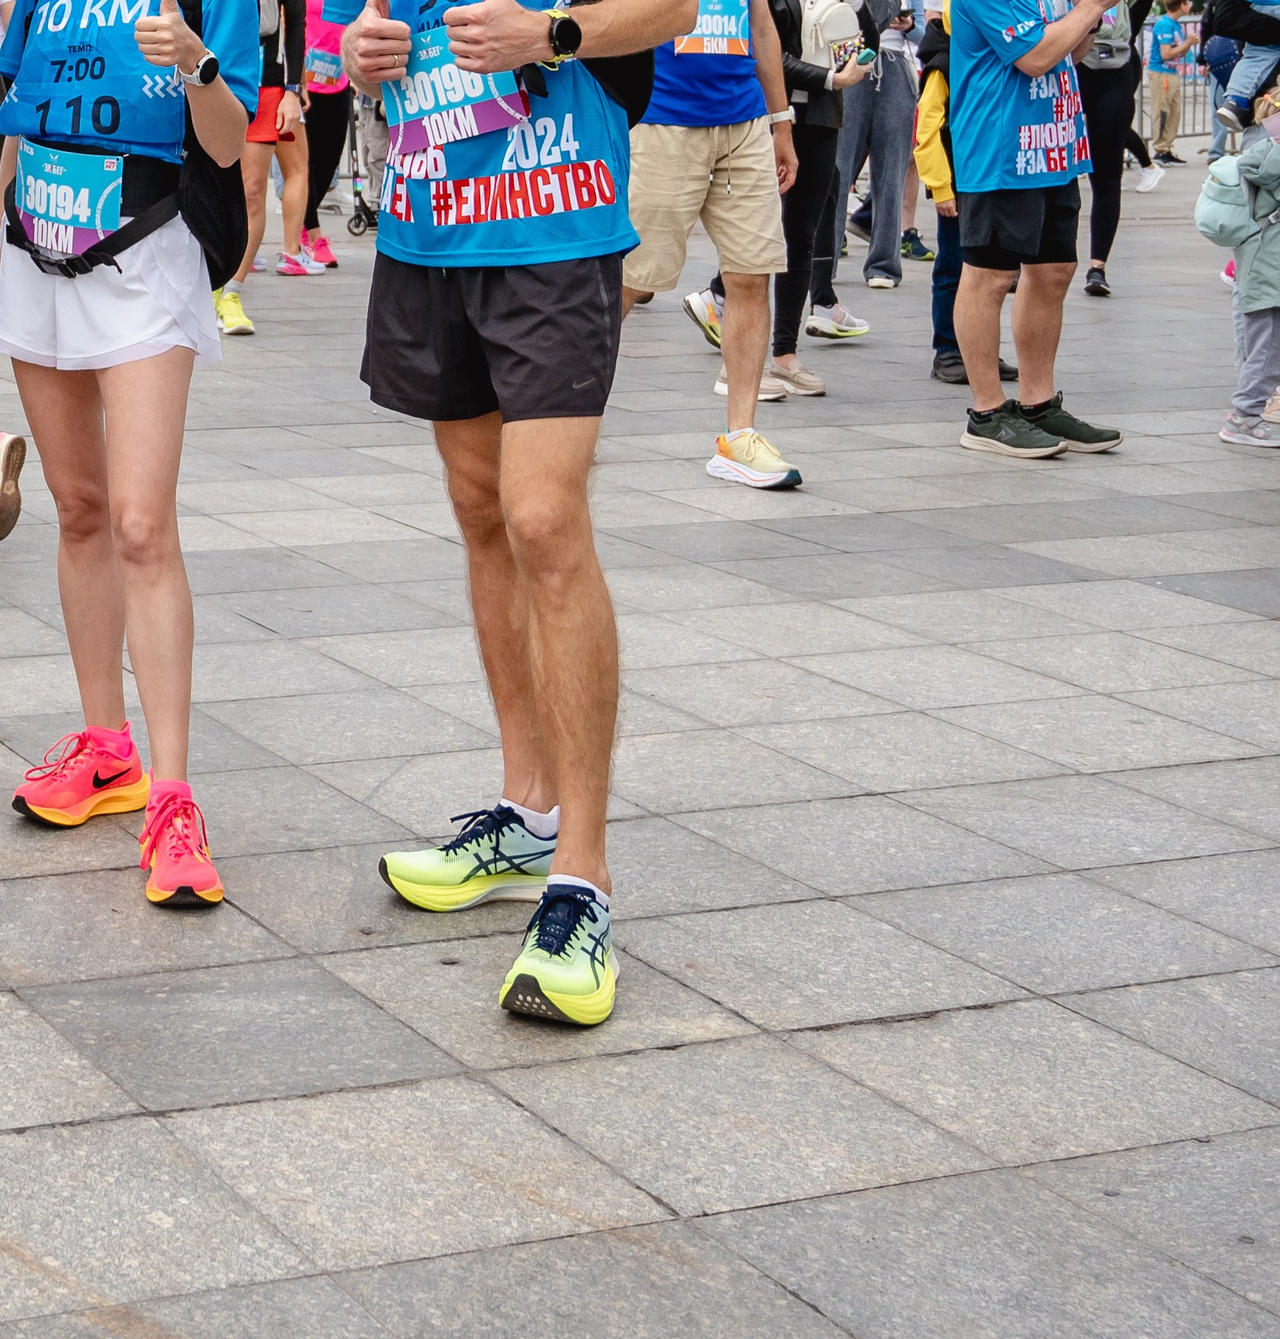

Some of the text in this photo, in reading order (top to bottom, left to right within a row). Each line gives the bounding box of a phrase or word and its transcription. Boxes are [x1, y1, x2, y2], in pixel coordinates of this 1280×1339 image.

[67, 44, 94, 53] ТЕМП:
[703, 37, 728, 54] 5KM
[51, 57, 106, 83] 7:00
[421, 104, 479, 146] 10KM
[23, 143, 35, 155] ПСБ
[502, 113, 580, 171] 2024
[1016, 147, 1068, 176] #ЗАБЕ
[26, 175, 91, 223] 30194
[430, 160, 616, 226] #ЕДИНСТВО
[33, 216, 74, 254] 10KM
